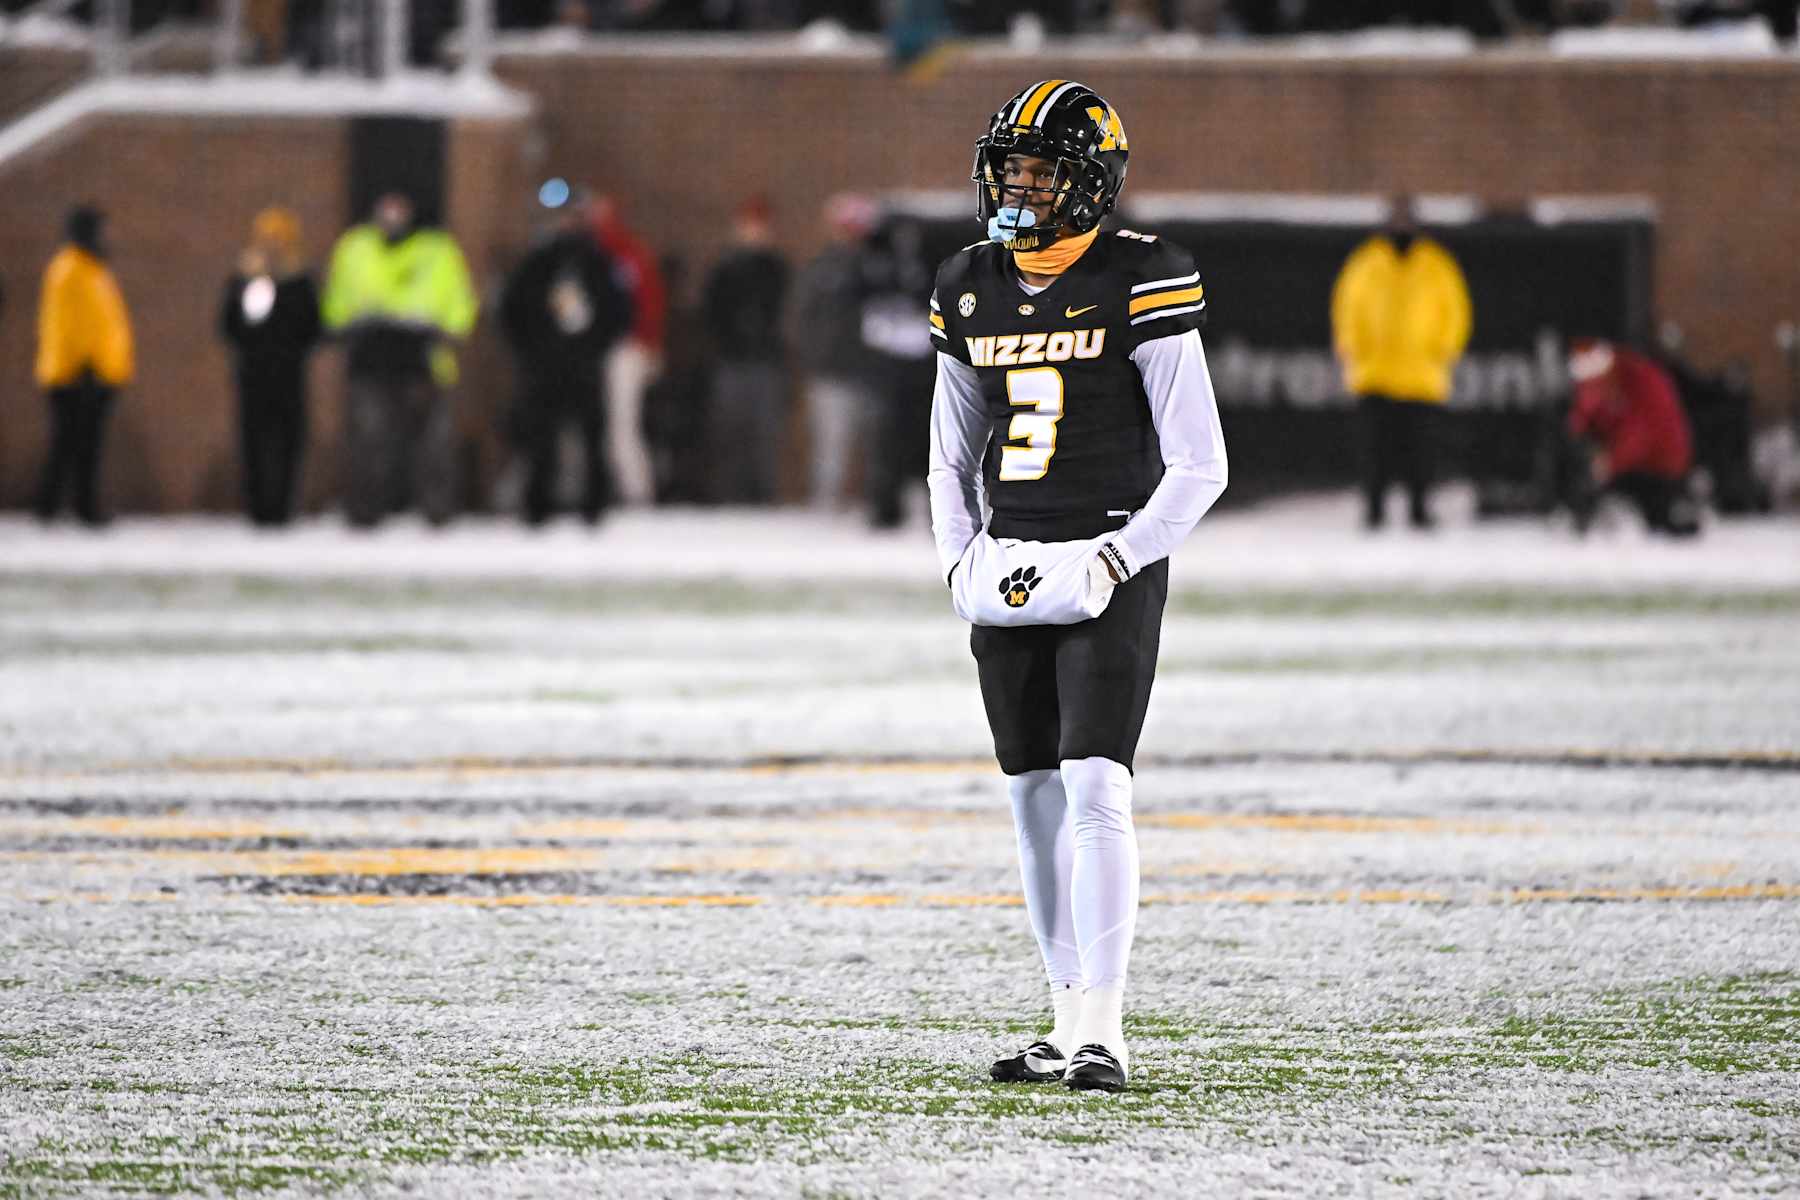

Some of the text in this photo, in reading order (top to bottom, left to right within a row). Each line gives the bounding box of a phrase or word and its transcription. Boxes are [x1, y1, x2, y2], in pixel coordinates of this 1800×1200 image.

[965, 328, 1106, 366] MIZZOU
[999, 367, 1064, 481] 3
[1010, 591, 1026, 605] M
